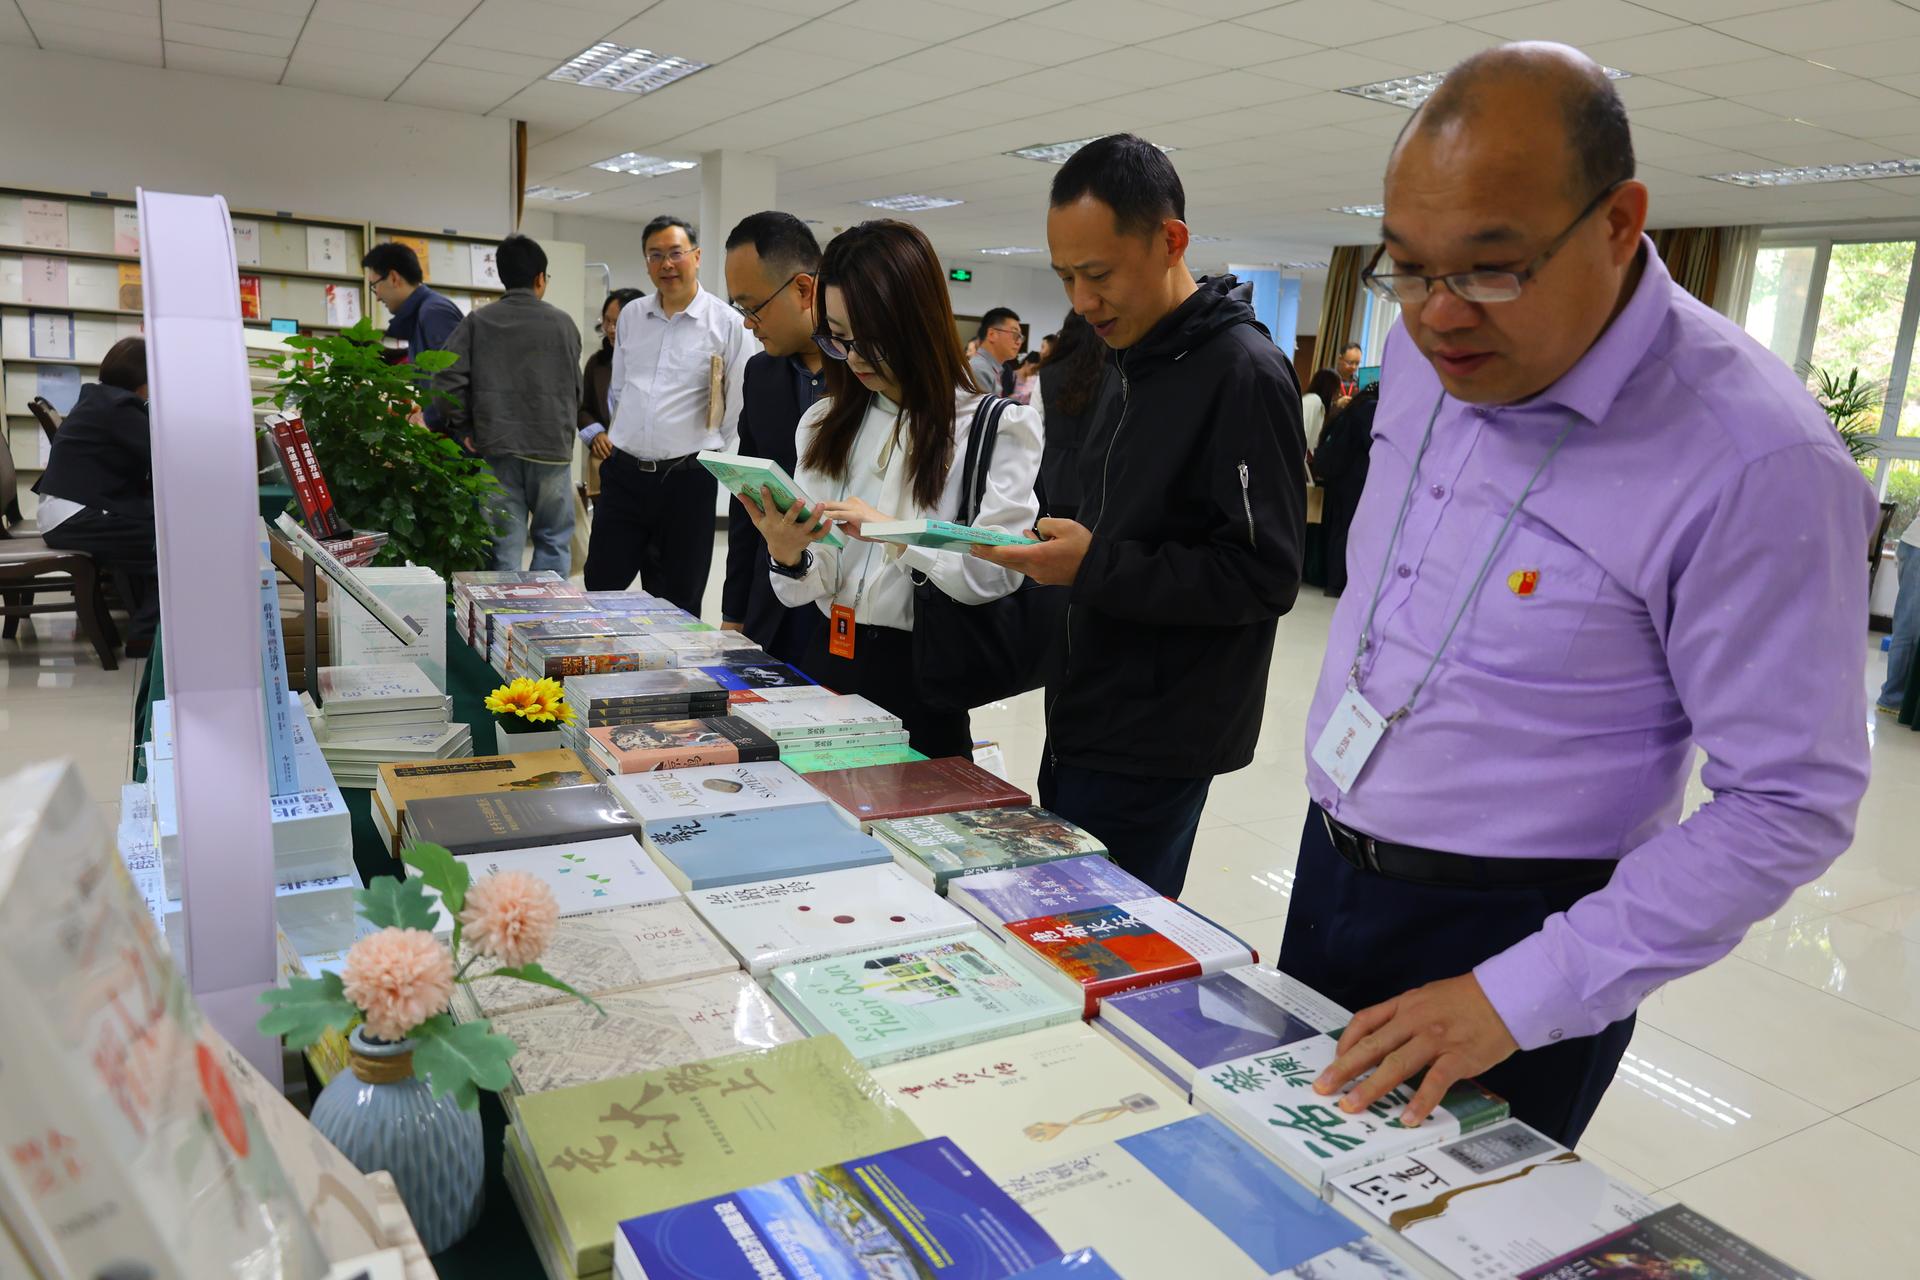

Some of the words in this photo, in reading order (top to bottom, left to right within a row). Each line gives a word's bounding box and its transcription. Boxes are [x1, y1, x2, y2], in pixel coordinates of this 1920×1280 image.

[651, 770, 707, 808] 人类简史
[735, 767, 776, 800] SAPIENS
[650, 819, 707, 846] 繁花
[705, 880, 817, 905] 丝路驼铃
[1030, 914, 1144, 943] 唐都长安
[825, 964, 866, 996] Own
[829, 1000, 876, 1044] Rooms
[868, 998, 909, 1043] Their
[1210, 1051, 1317, 1098] 蔡澜
[1350, 1156, 1452, 1209] 问道
